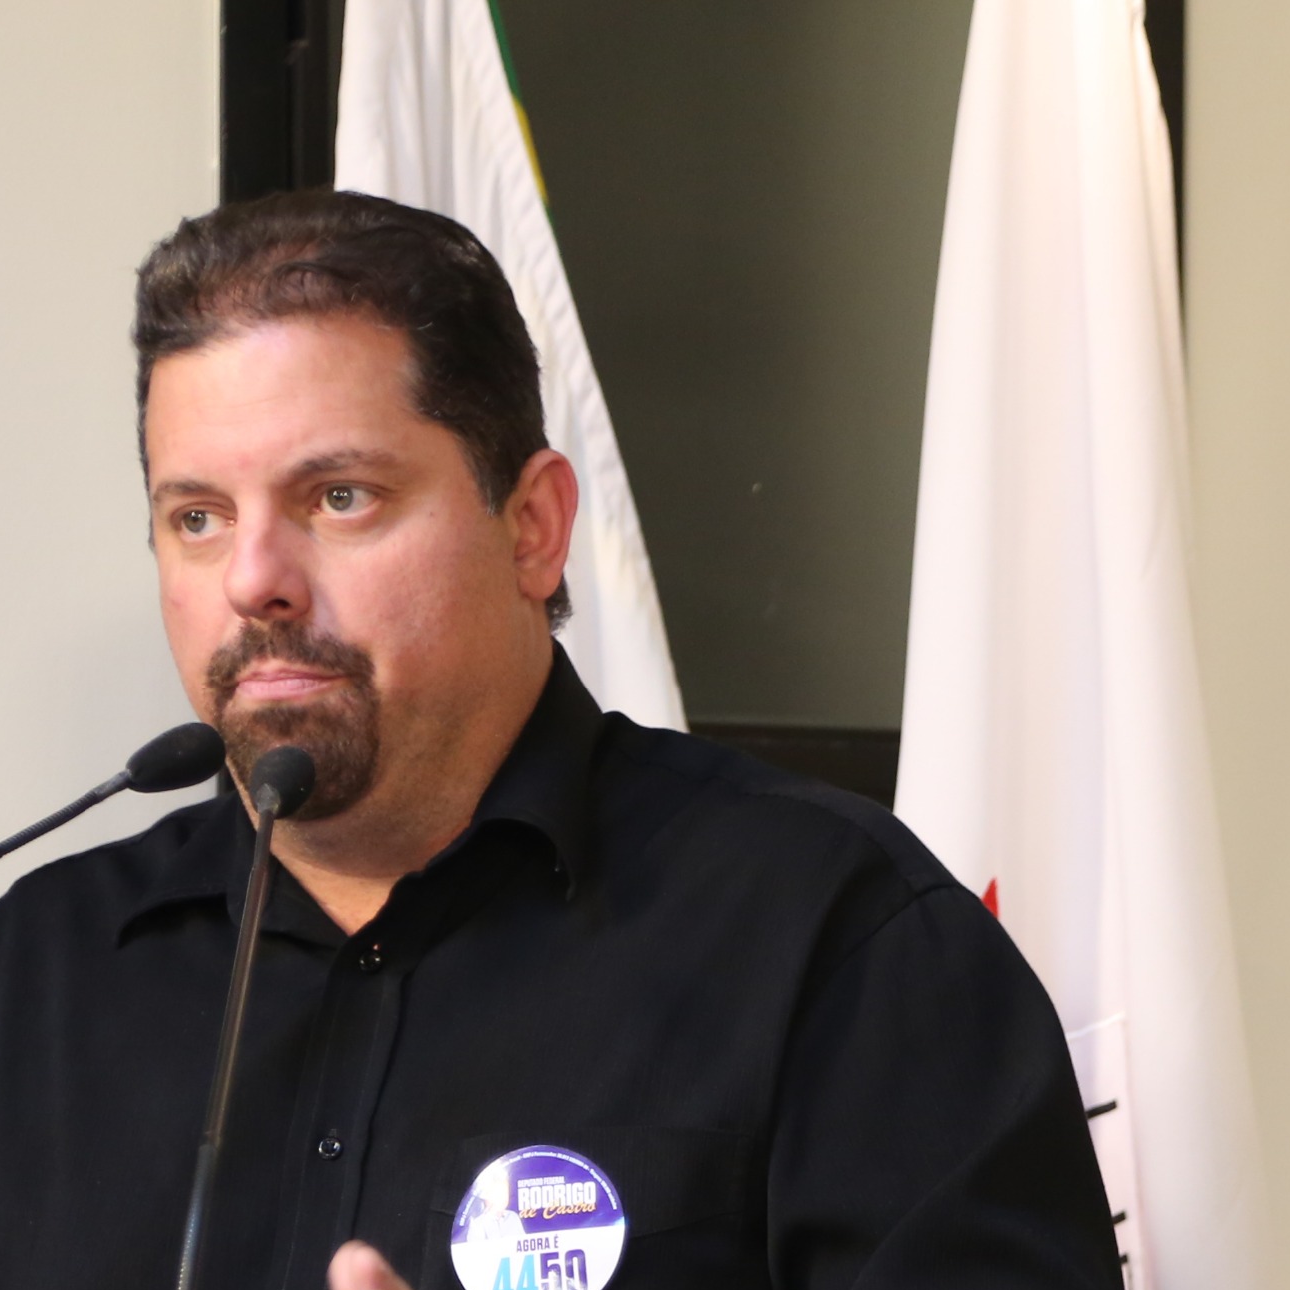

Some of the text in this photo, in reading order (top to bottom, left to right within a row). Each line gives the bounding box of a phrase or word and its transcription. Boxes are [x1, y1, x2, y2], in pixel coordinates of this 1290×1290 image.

[518, 1181, 596, 1211] RODRIGO
[542, 1201, 596, 1219] Castro
[516, 1233, 559, 1252] AGORA É
